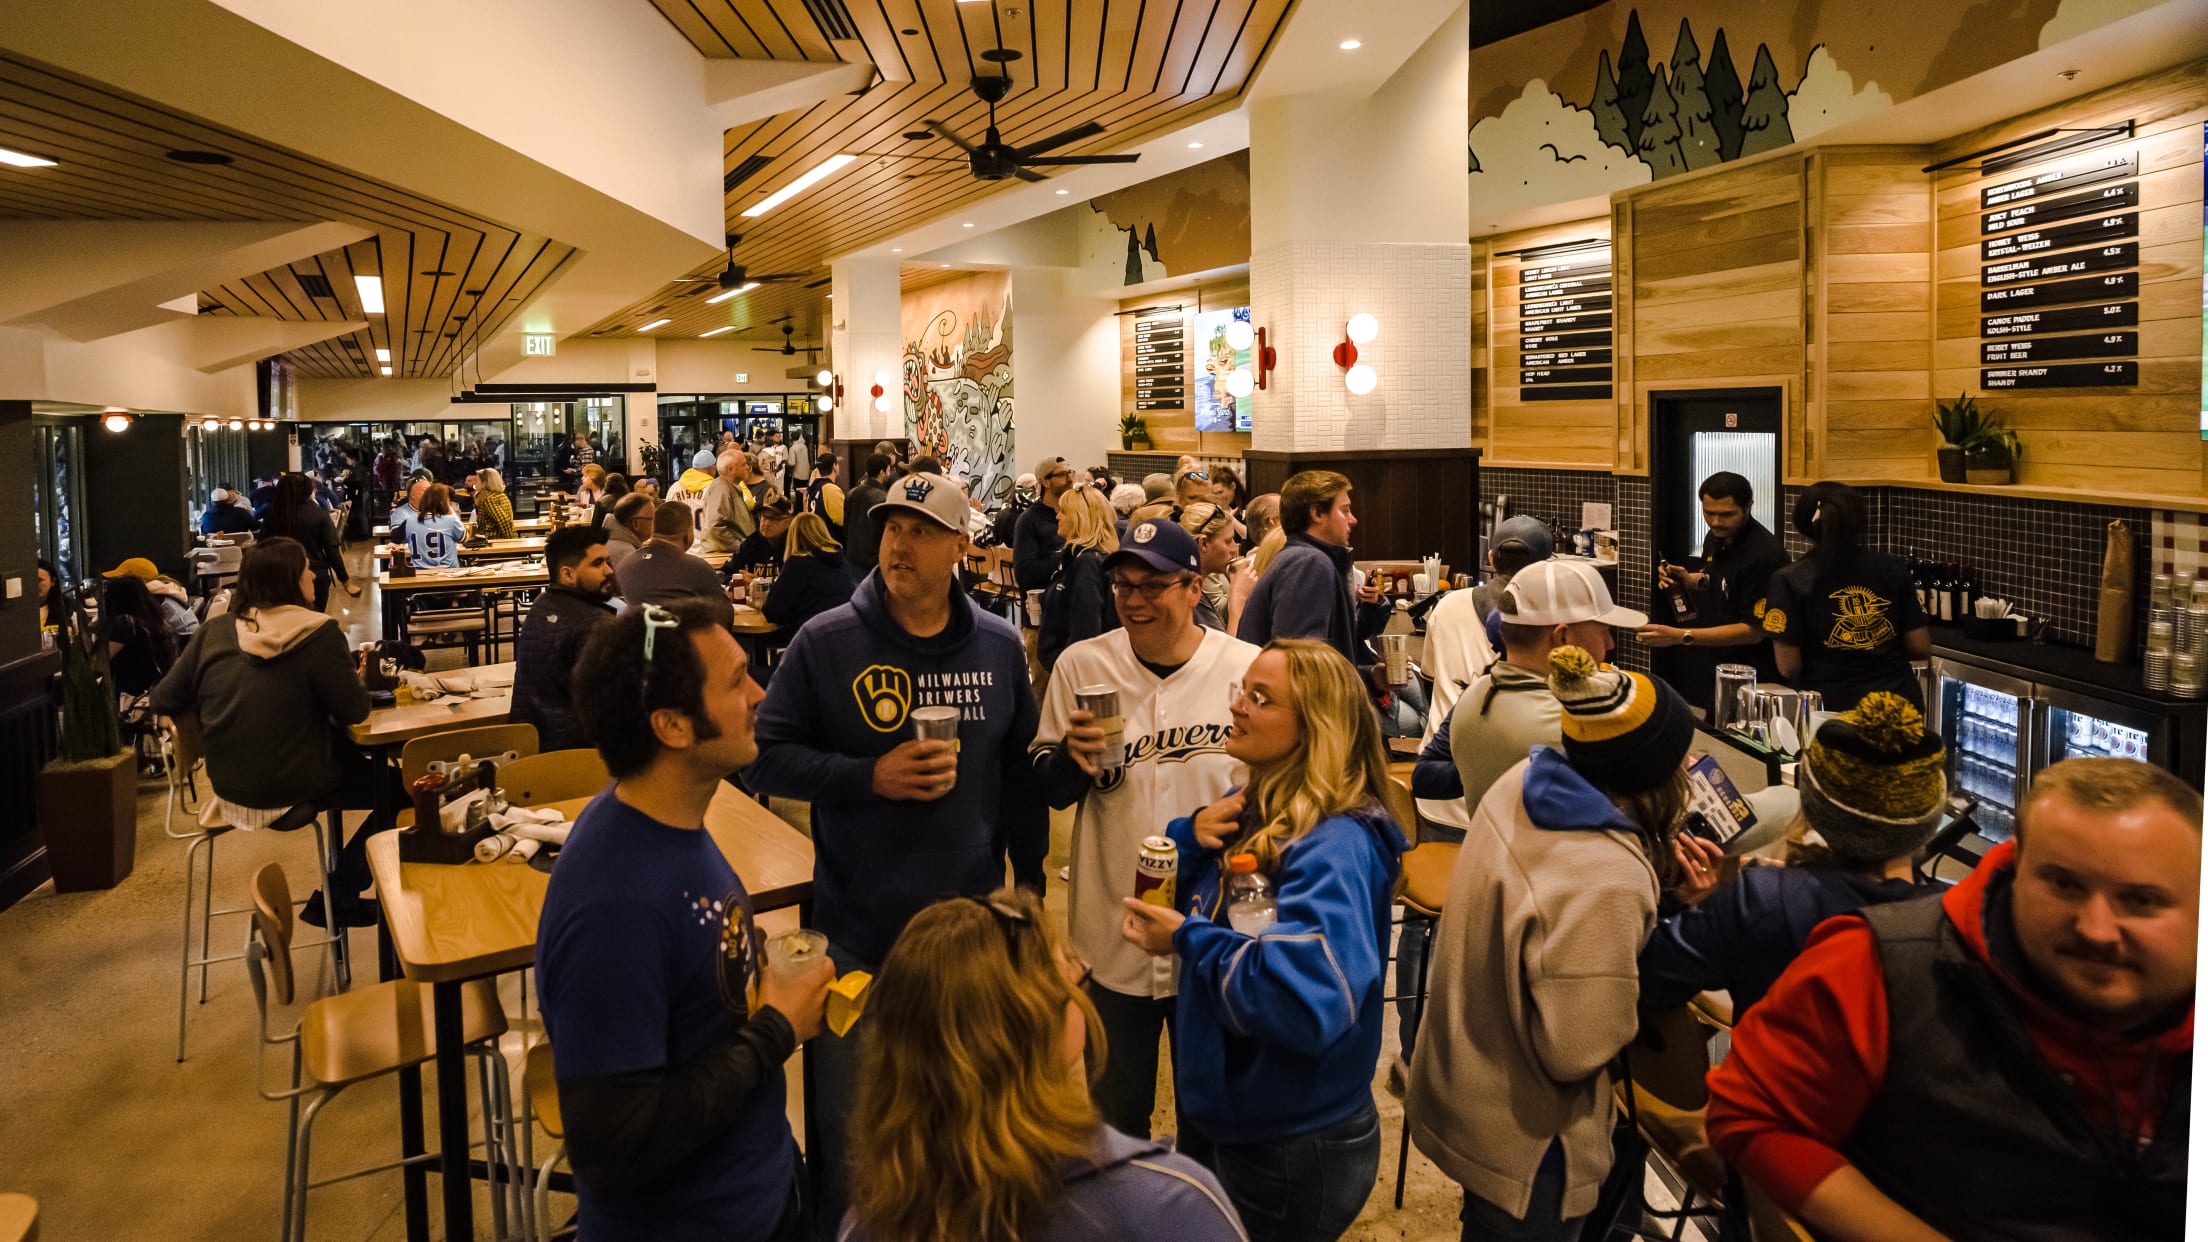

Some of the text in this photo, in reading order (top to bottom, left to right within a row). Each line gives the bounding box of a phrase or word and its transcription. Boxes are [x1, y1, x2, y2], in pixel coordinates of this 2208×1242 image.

[2012, 188, 2034, 199] LAGER
[2011, 206, 2034, 217] PEACH
[2007, 218, 2025, 227] SOUR
[1989, 233, 2040, 248] HONEY WEISS
[1988, 262, 2086, 283] ENGLISH-STYLE AMBER ALE
[1987, 288, 2034, 300] DARK LAGER
[2104, 306, 2121, 314] 5.0%
[1987, 314, 2040, 325] CANOE PADDLE
[526, 336, 552, 354] EXIT
[1987, 342, 2032, 352] BERRY WEISS
[1987, 369, 2047, 378] SUMMER SHANDY
[411, 531, 446, 560] 19
[918, 672, 992, 688] MILWAUKEE
[1139, 854, 1174, 869] VIZZY
